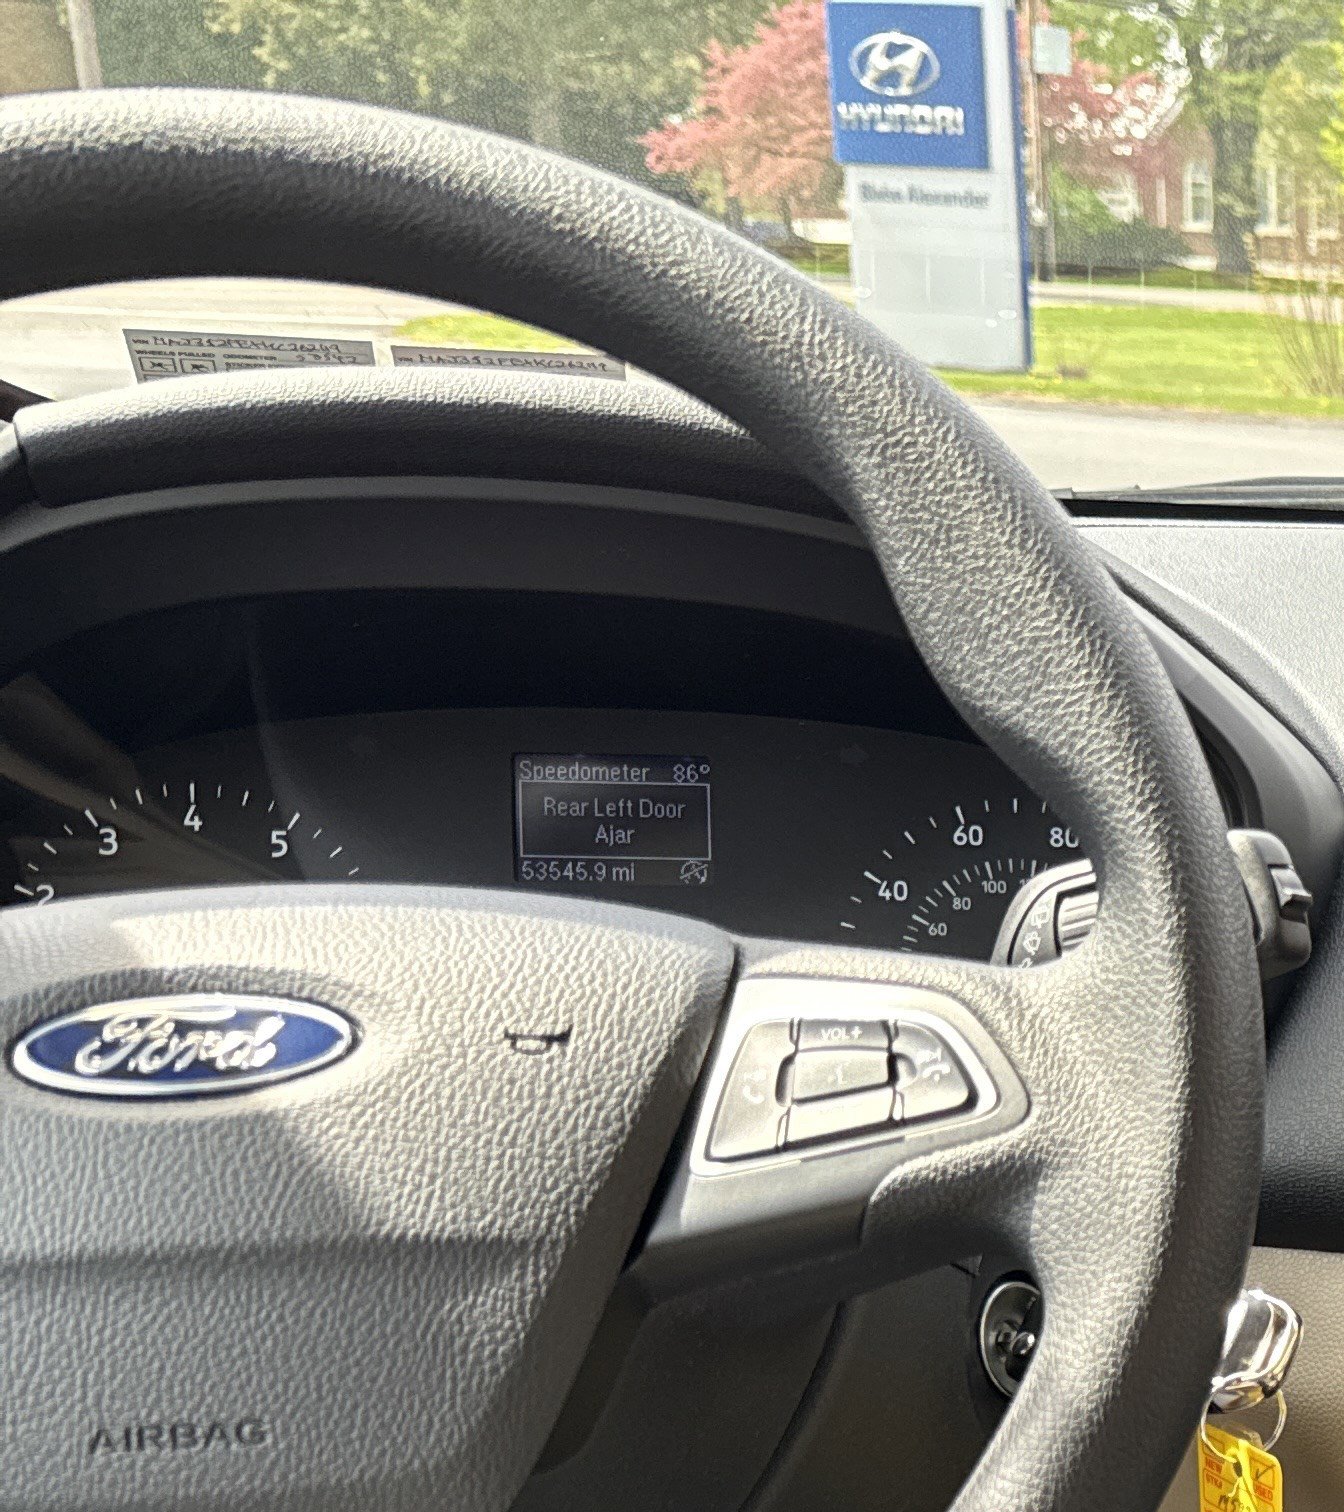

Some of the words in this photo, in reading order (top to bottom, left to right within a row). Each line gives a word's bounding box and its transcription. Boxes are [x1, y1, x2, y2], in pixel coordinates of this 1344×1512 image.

[519, 760, 651, 783] Speedometer
[183, 804, 203, 832] 4
[543, 796, 589, 817] Rear
[594, 798, 634, 818] Left
[639, 799, 687, 819] Door
[98, 828, 119, 856] 3
[271, 830, 289, 858] 5
[595, 824, 636, 846] Ajar
[952, 825, 984, 846] 60
[612, 862, 636, 882] mi
[877, 880, 909, 901] 40
[981, 880, 1008, 894] 100
[952, 897, 972, 911] 80
[928, 923, 948, 936] 60
[74, 1006, 287, 1074] Ford
[88, 1416, 272, 1455] AIRBAG
[1205, 1457, 1223, 1474] NEW
